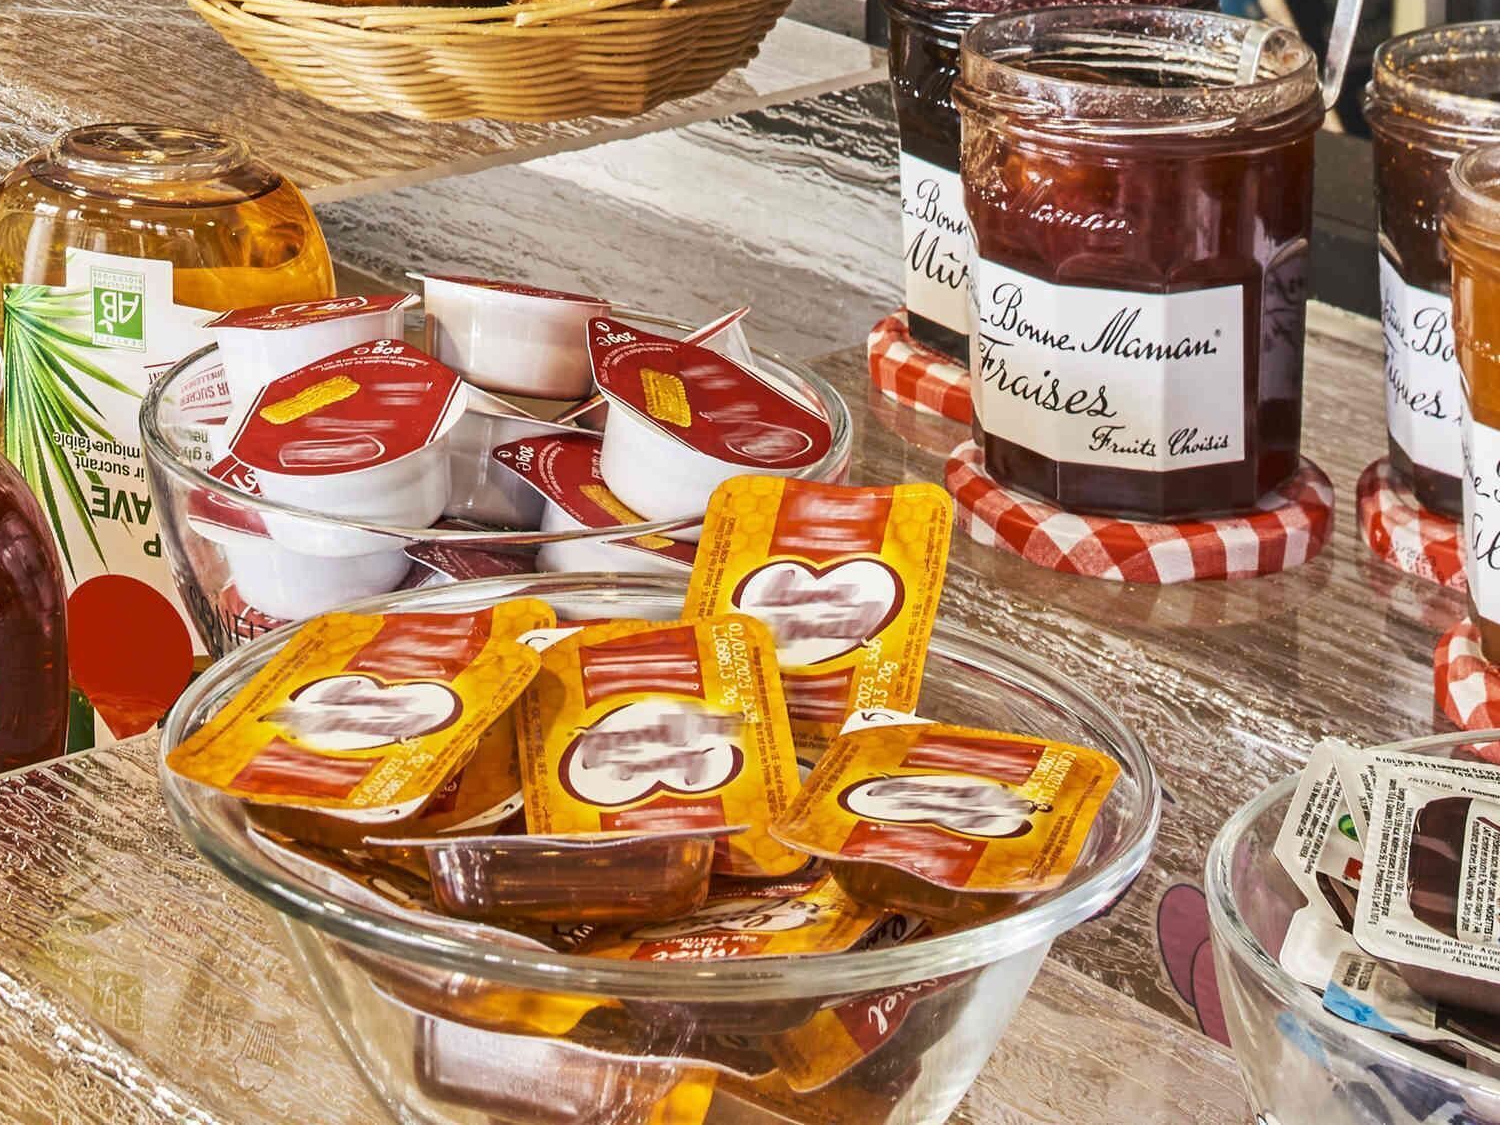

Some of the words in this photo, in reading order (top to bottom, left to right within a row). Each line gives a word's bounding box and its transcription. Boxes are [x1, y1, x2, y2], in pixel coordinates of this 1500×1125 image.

[100, 291, 140, 325] AB
[991, 282, 1076, 351] Bonne
[1081, 307, 1218, 362] Maman
[979, 332, 1117, 418] Fraises
[53, 432, 91, 453] faible
[1089, 425, 1157, 457] Fruits
[1168, 427, 1228, 457] Choisis
[75, 456, 130, 476] sucrant
[91, 485, 152, 525] AVE
